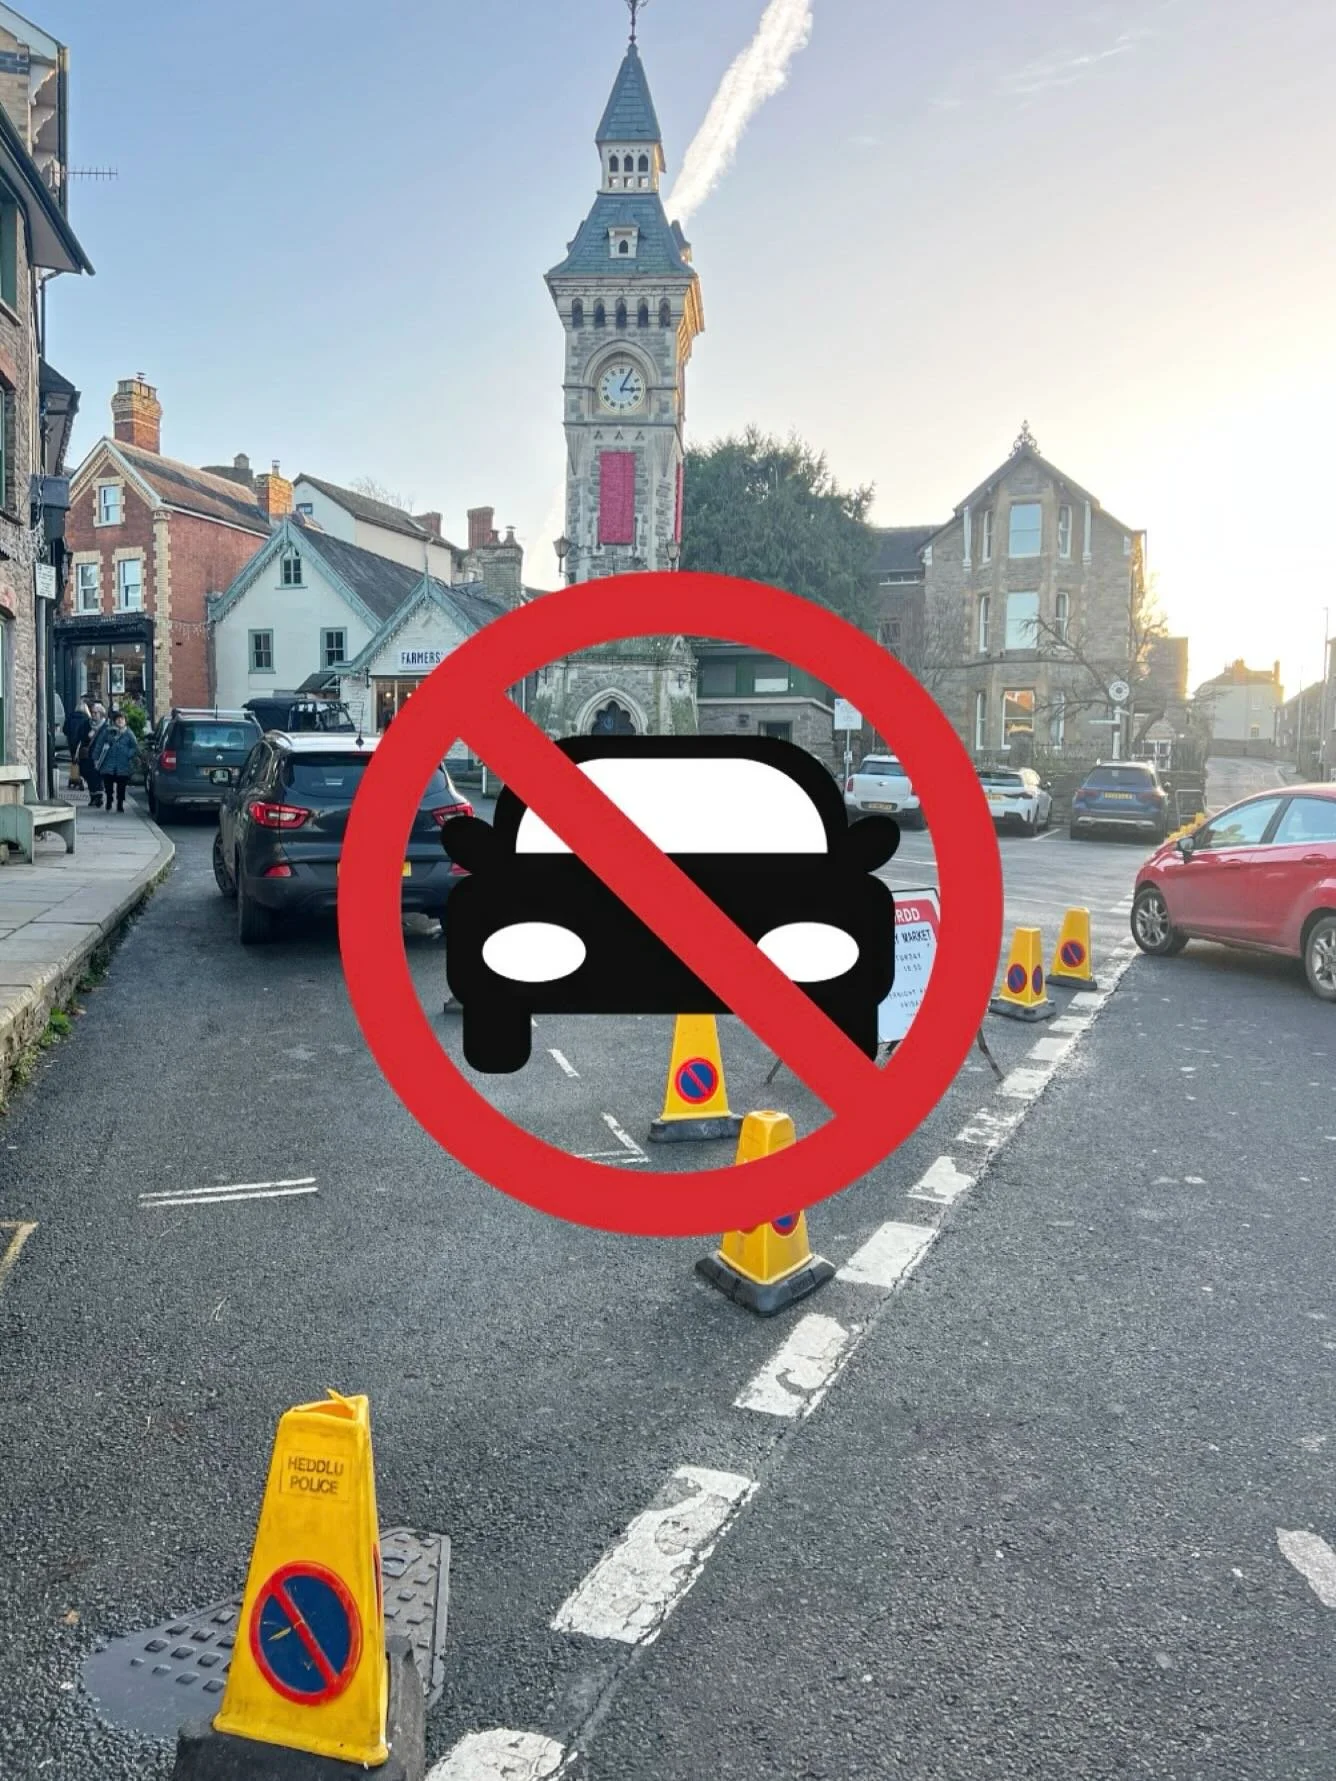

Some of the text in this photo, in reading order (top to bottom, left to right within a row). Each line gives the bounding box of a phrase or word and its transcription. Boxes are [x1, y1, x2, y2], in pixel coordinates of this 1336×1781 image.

[894, 907, 920, 923] RDD
[901, 929, 931, 943] MARKET
[288, 1455, 344, 1476] HEDDLU
[290, 1474, 338, 1494] POLICE
